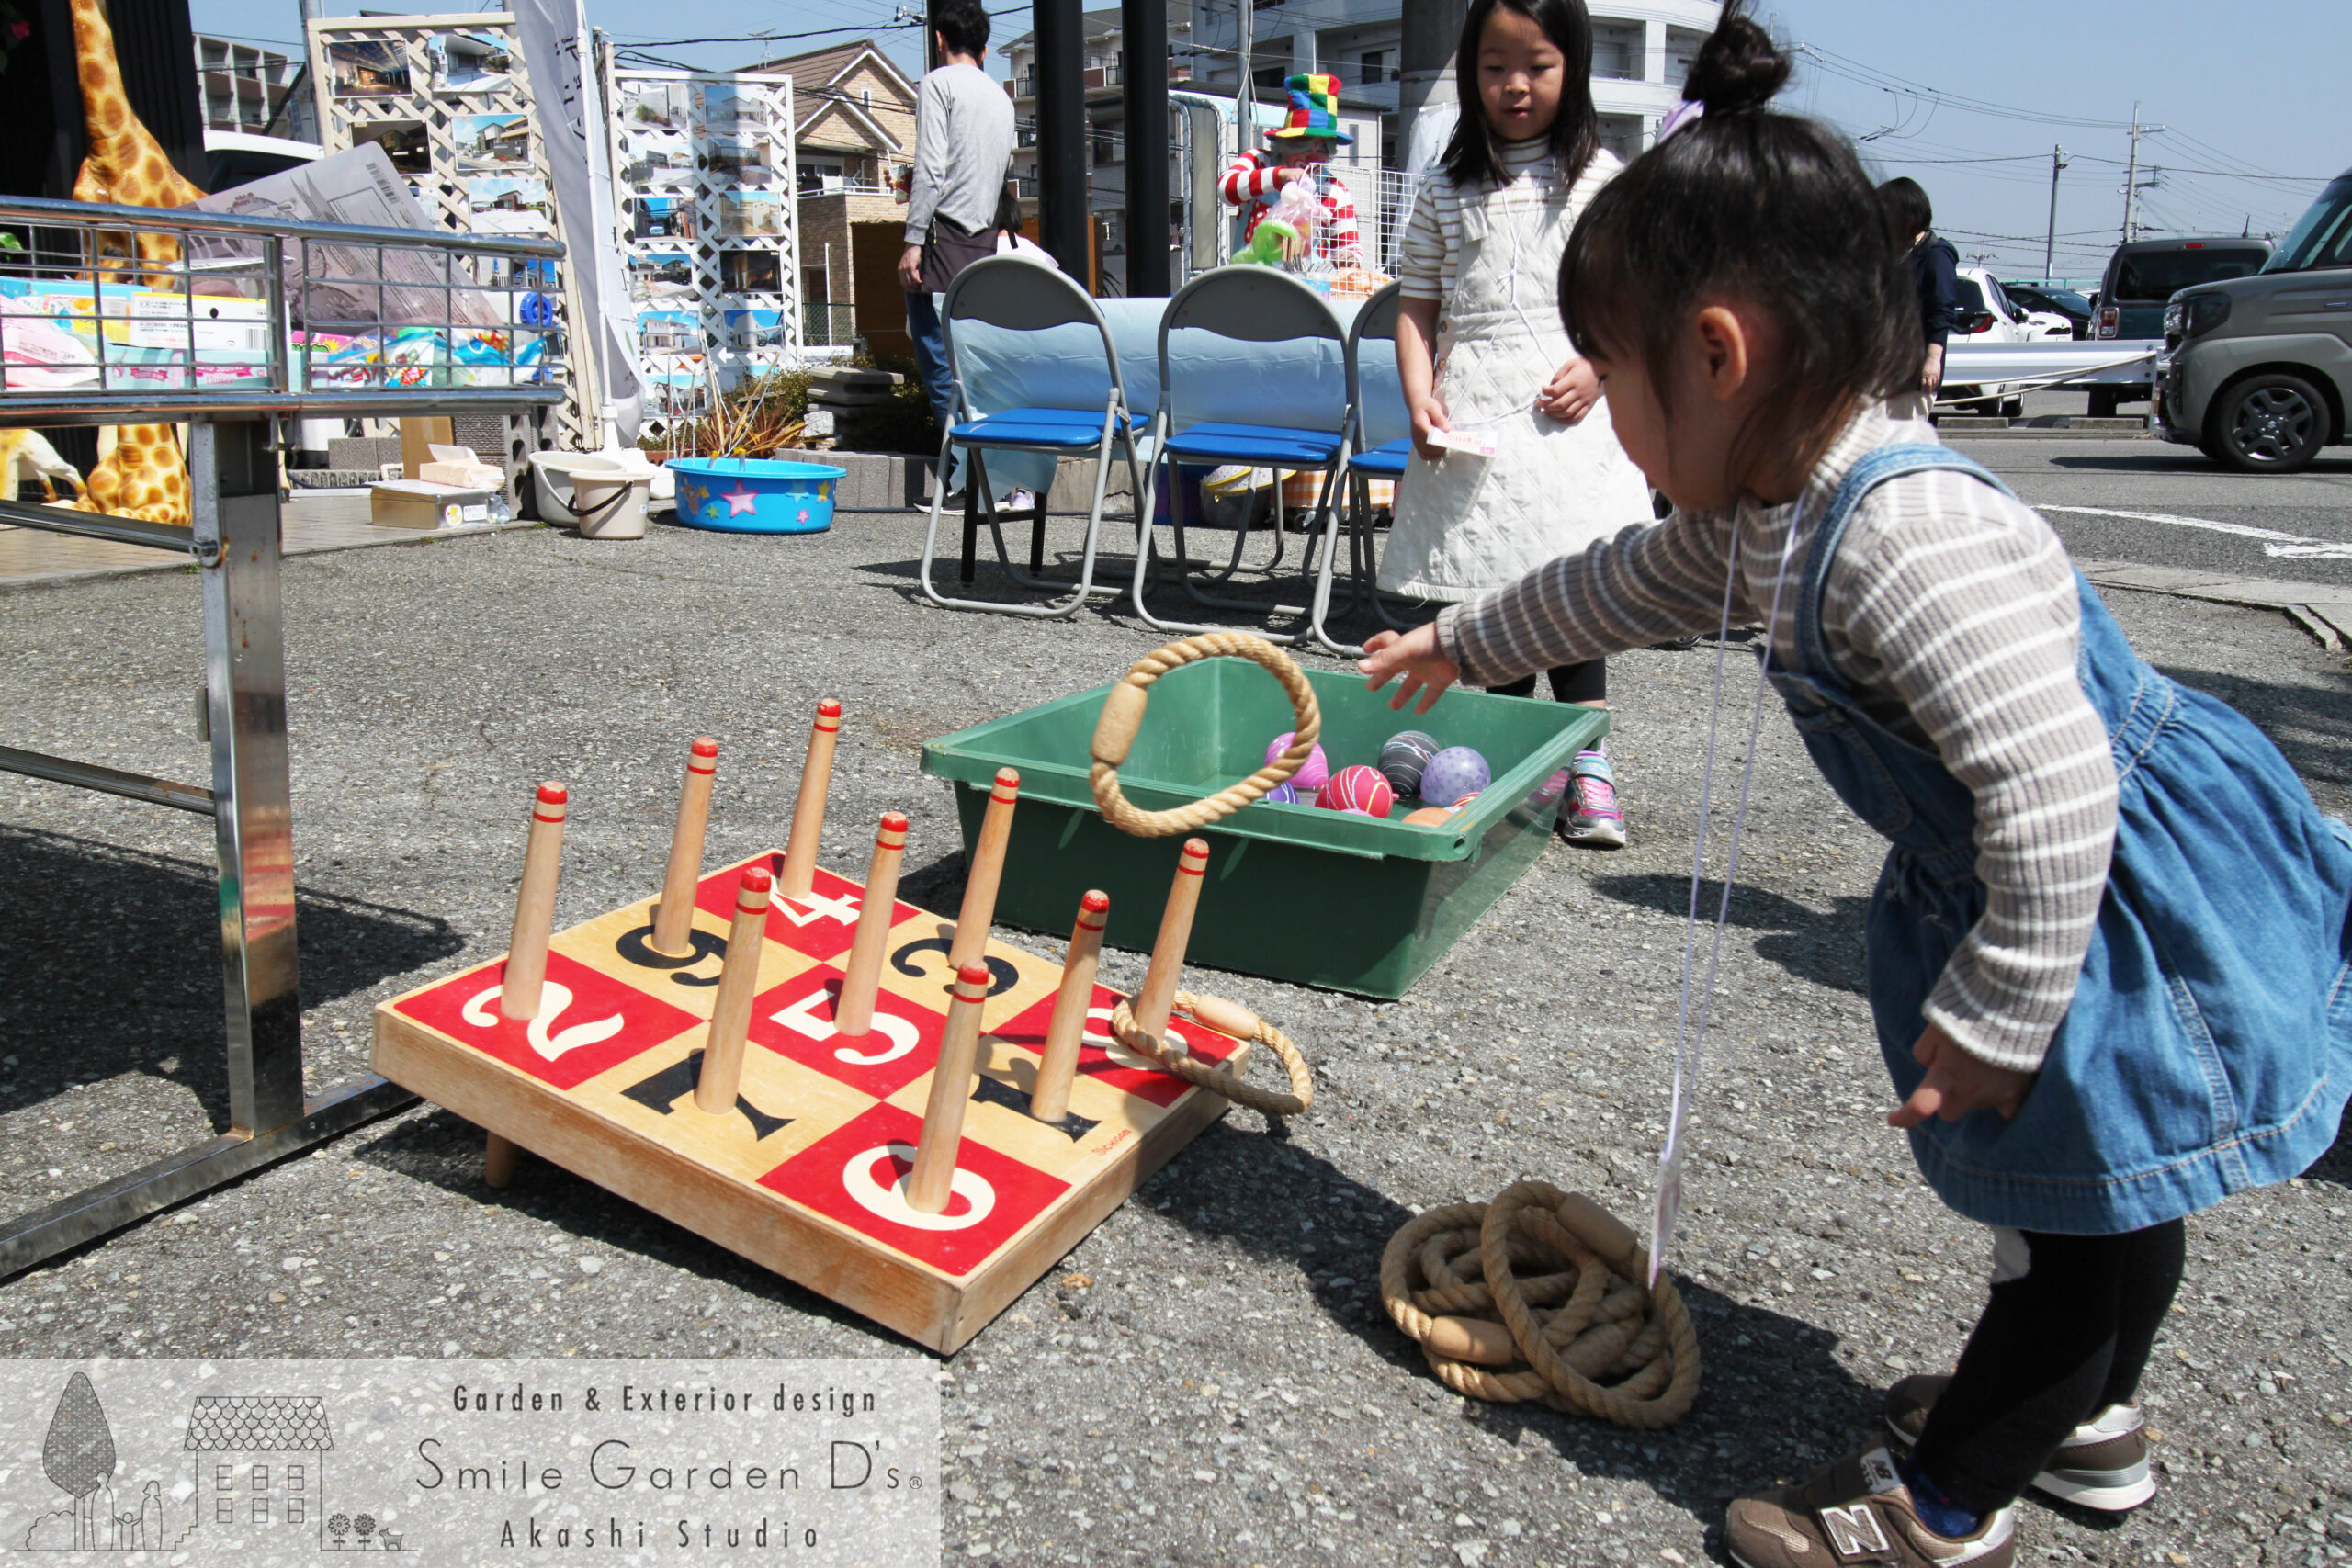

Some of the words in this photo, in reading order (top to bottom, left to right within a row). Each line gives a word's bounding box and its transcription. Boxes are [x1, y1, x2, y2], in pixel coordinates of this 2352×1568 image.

[461, 979, 624, 1062] 2
[616, 924, 729, 987] 9
[770, 874, 862, 928] 4
[769, 988, 920, 1066] 5
[891, 937, 1019, 998] 3
[842, 1145, 996, 1231] 6
[1820, 1504, 1890, 1555] N
